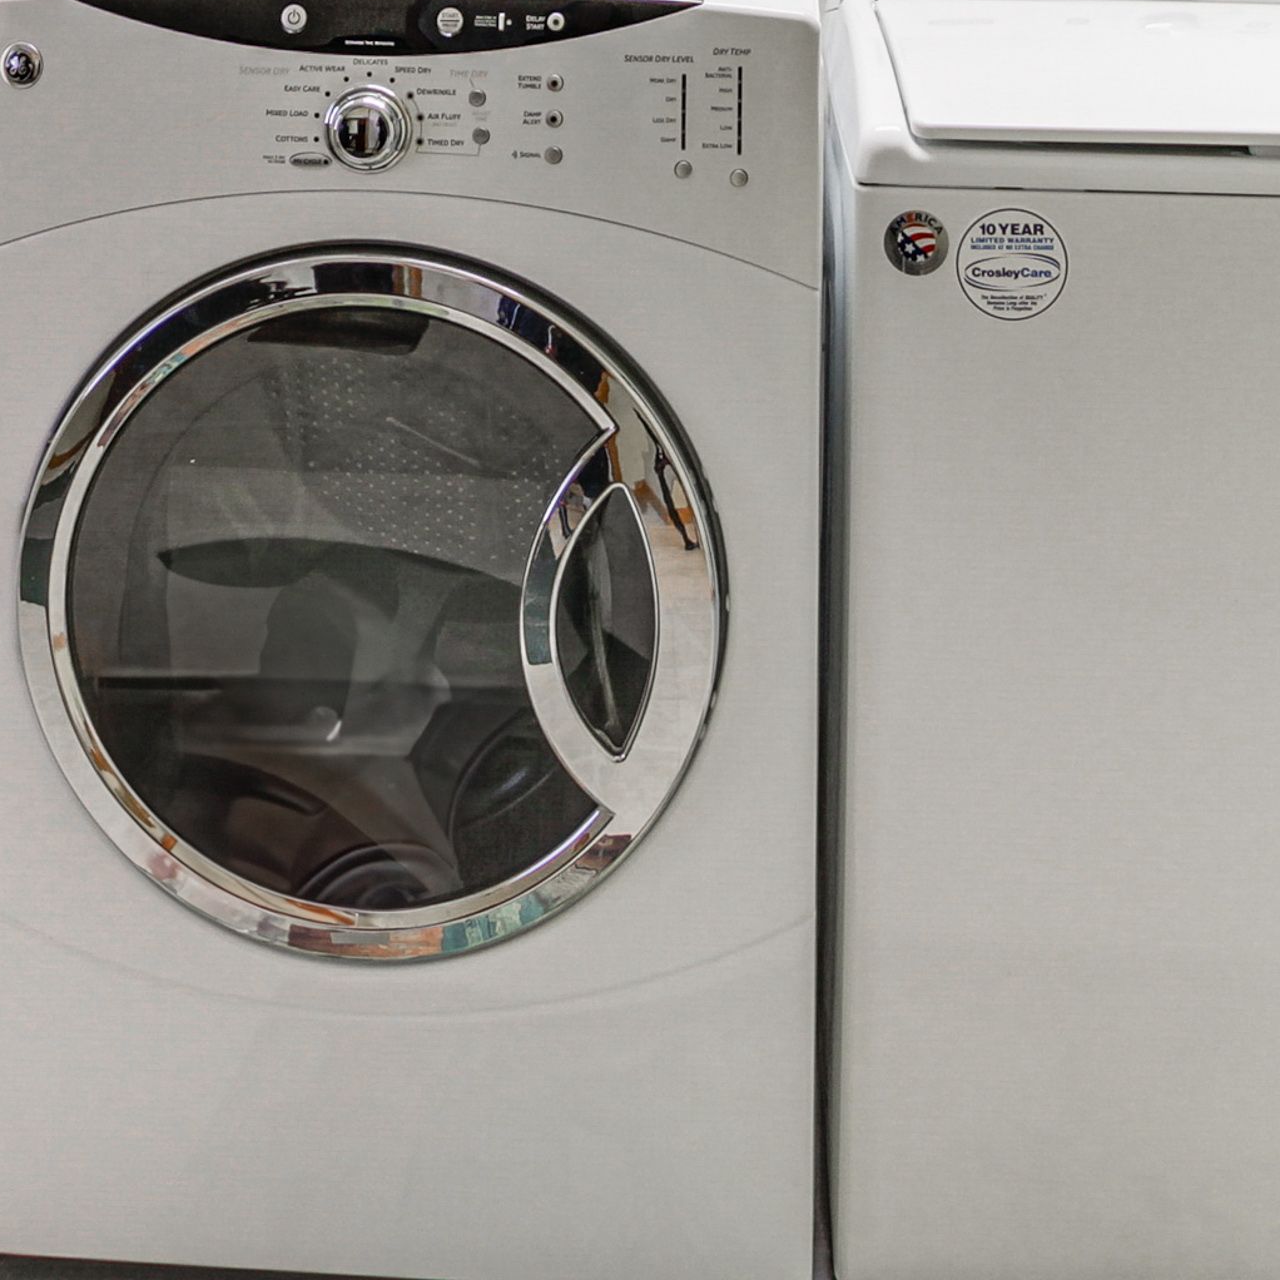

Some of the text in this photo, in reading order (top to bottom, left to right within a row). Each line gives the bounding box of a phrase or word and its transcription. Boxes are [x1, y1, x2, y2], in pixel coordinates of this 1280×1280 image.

[525, 14, 546, 22] DELAY
[525, 22, 545, 31] START
[712, 47, 752, 56] DRY TEMP
[352, 57, 389, 66] DELICATES
[624, 54, 695, 64] SENSOR DRY LEVEL
[299, 64, 323, 72] ACTIVE
[394, 65, 432, 75] SPEED DRY
[283, 84, 321, 93] EASY CARE
[416, 87, 457, 96] DEWRINKLE
[265, 108, 309, 117] MIXED LOAD
[427, 112, 440, 120] AIR
[440, 112, 462, 121] FLUFF
[275, 134, 309, 143] COTTONS
[427, 138, 465, 147] TIMED DRY
[889, 211, 944, 237] AMERICA
[979, 223, 1045, 236] 10 YEAR
[971, 267, 1052, 280] CrosleyCare
